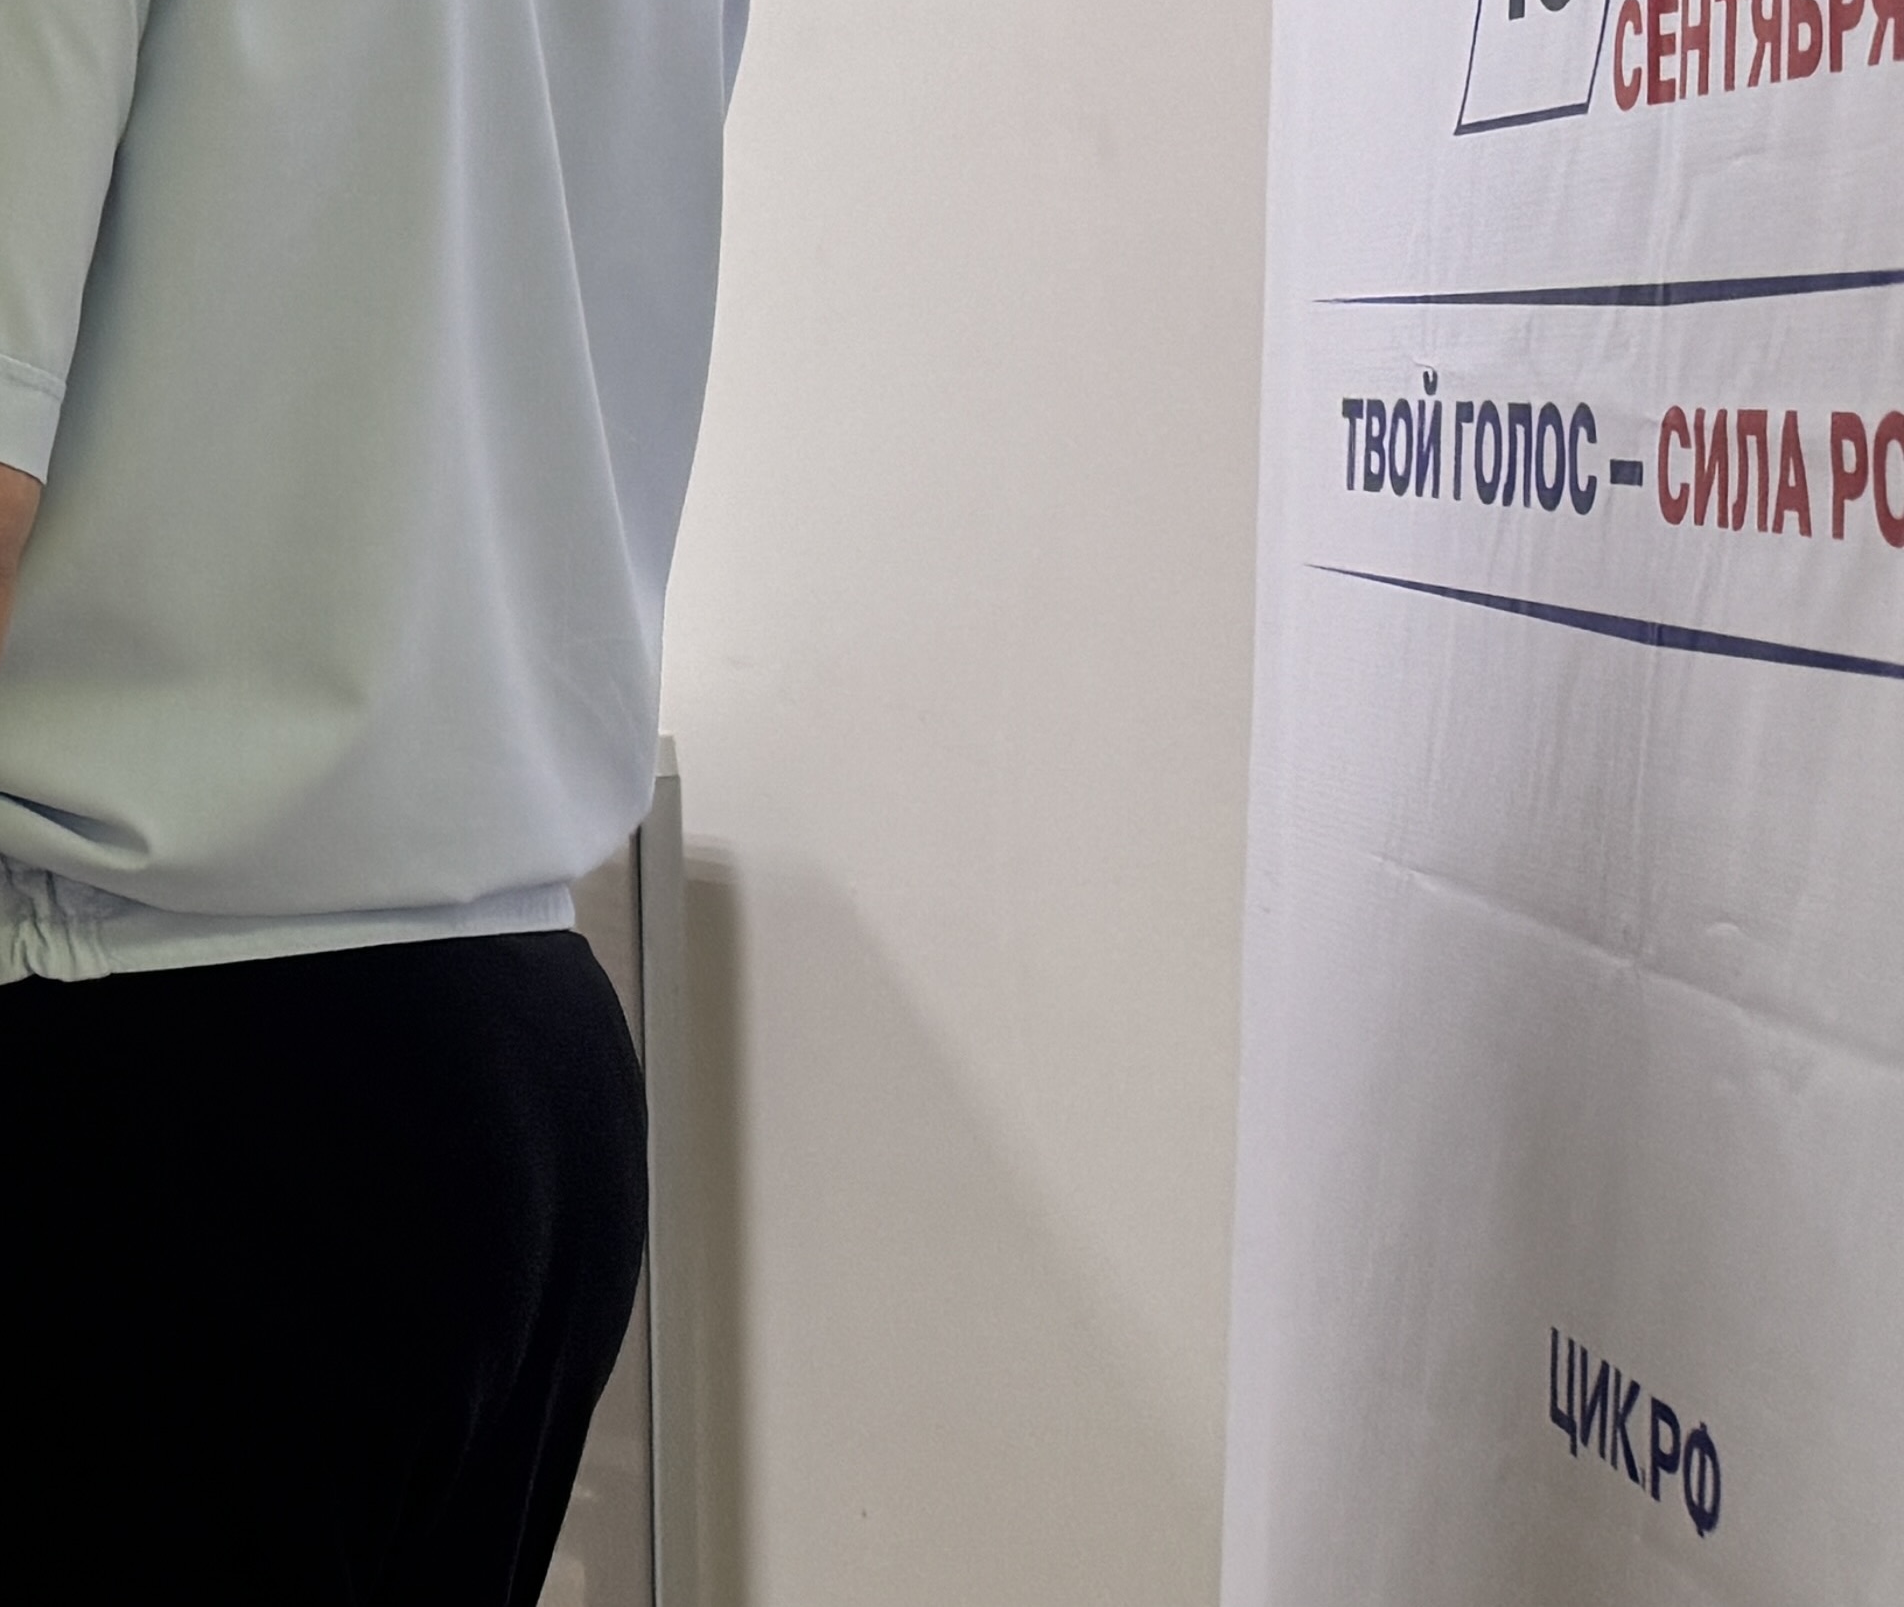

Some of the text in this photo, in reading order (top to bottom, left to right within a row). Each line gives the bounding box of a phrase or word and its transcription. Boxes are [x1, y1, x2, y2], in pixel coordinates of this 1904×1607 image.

[1342, 370, 1442, 499] ТВОЙ
[1453, 398, 1597, 515] ГОЛОС
[1658, 405, 1812, 538] СИЛА
[1550, 1326, 1721, 1539] ЦИК.РФ
